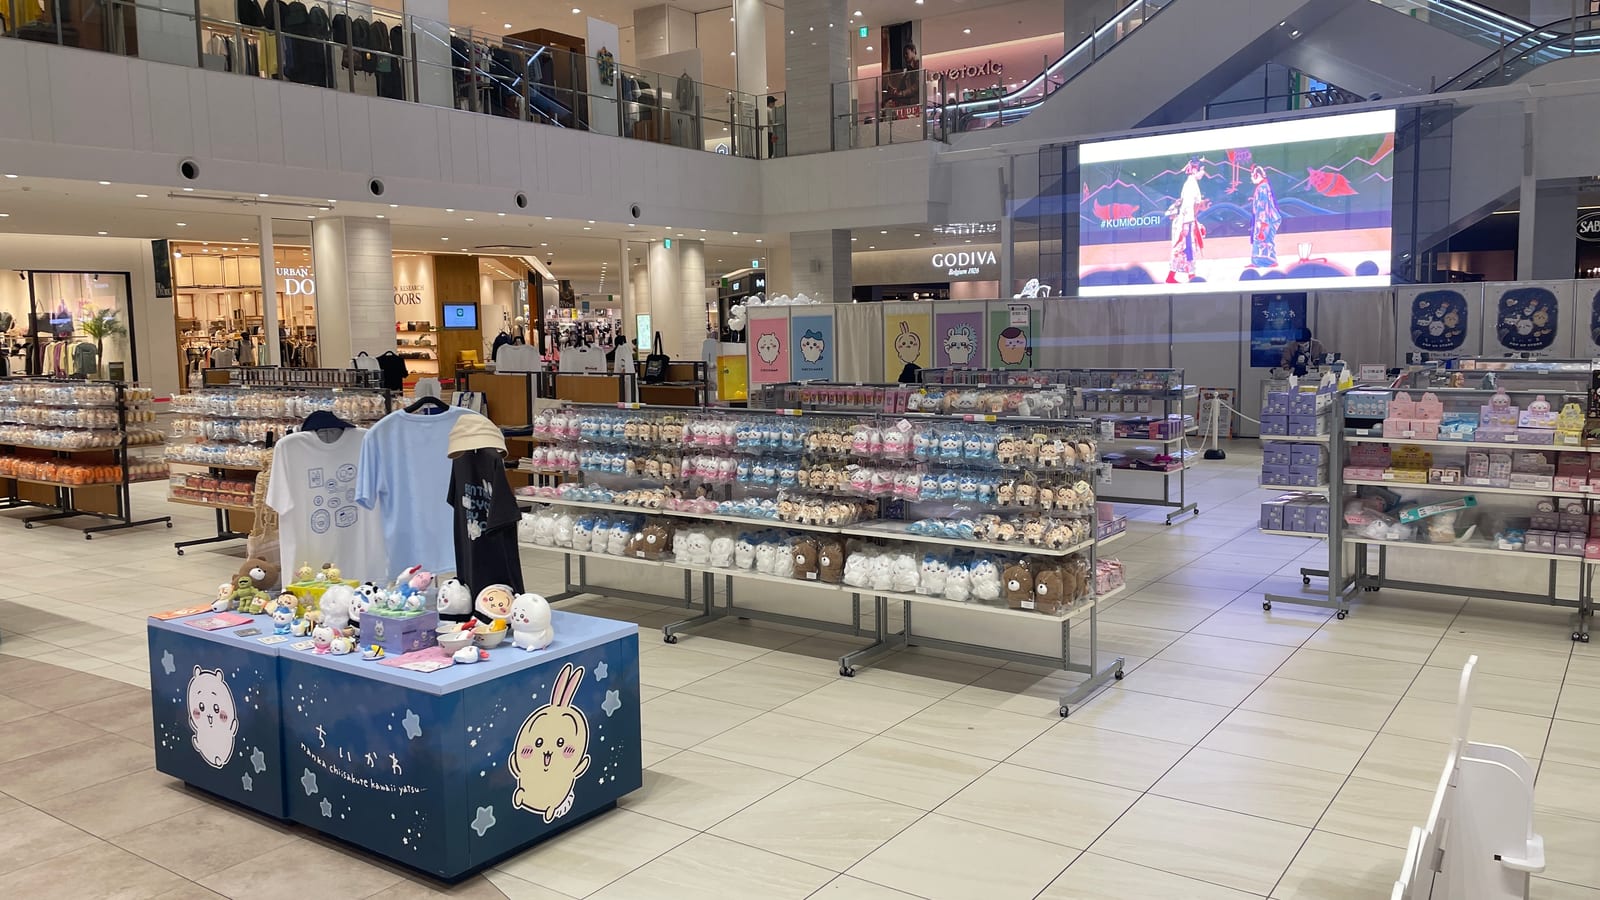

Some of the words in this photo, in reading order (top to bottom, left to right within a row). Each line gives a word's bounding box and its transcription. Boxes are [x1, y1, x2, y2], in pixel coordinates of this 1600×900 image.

[1100, 215, 1161, 229] #KUMIODORI
[932, 250, 997, 268] GODIVA
[275, 267, 309, 277] URBAN
[315, 724, 402, 775] ちいかわ
[300, 742, 327, 768] nanka
[329, 764, 369, 788] chiisakute
[370, 779, 397, 792] kawaii
